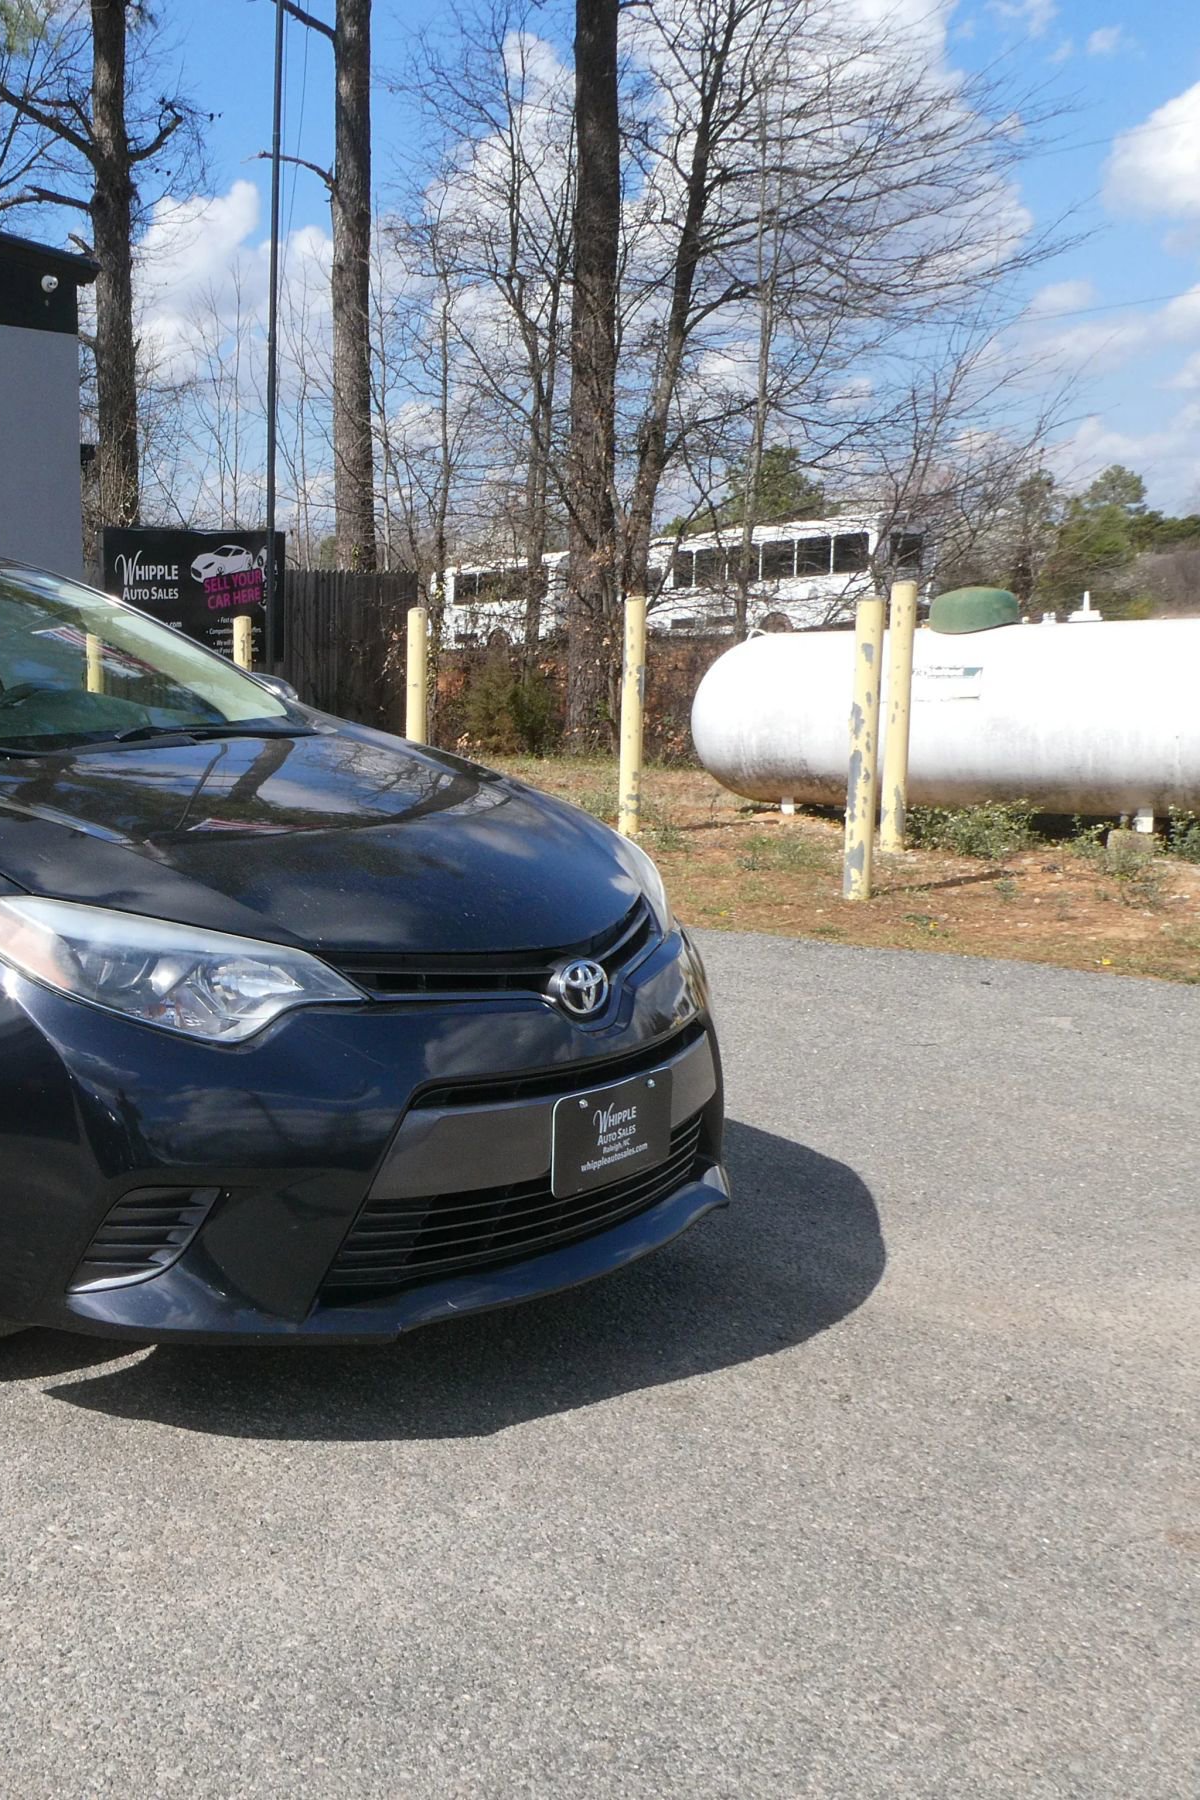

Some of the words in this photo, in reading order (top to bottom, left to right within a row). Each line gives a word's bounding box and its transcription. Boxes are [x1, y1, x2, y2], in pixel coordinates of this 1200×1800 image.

[114, 550, 179, 585] WHIPPLE
[204, 576, 230, 594] SELL
[231, 569, 263, 589] YOUR
[122, 587, 150, 601] AUTO
[151, 586, 179, 600] SALES
[207, 594, 231, 610] CAR
[233, 588, 261, 606] HERE
[592, 1102, 637, 1133] WHIPPLE
[597, 1132, 617, 1146] AUTO
[617, 1124, 636, 1139] SALES
